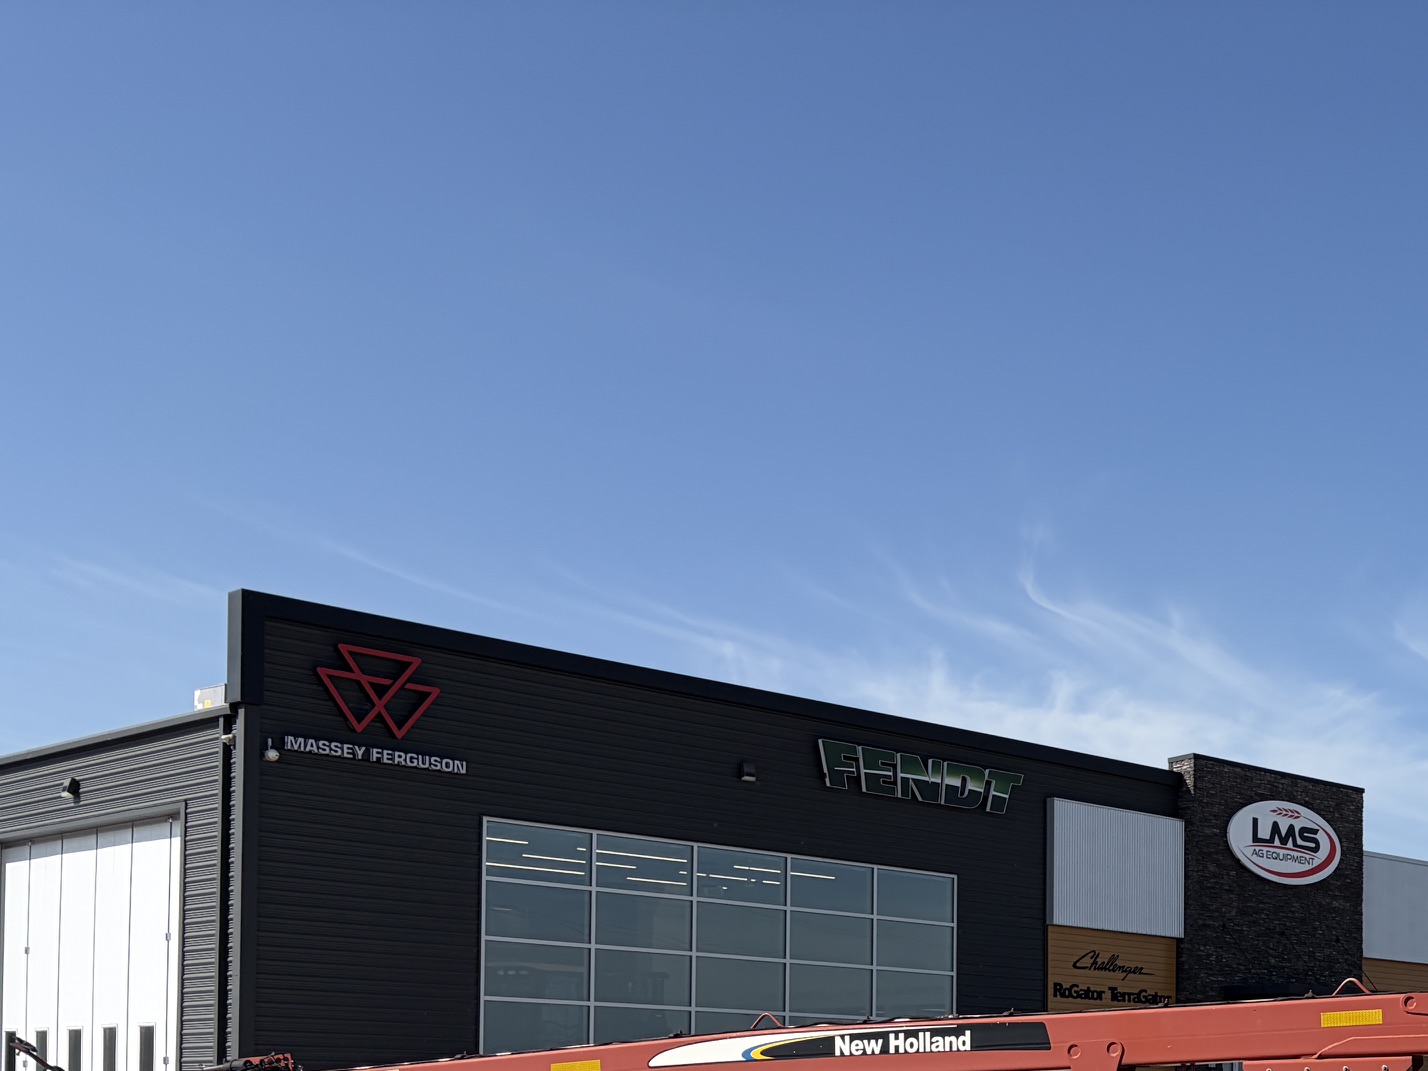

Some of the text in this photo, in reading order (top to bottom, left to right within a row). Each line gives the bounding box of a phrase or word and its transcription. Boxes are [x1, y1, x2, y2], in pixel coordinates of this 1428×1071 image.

[285, 735, 467, 774] MASSEY FERGUSON
[818, 738, 1024, 814] FENDT
[1252, 817, 1320, 854] LMS
[1251, 849, 1315, 866] AG EQUIPMENT
[1072, 950, 1155, 981] Challenger
[1053, 982, 1172, 1005] RoGator TerraGator
[834, 1030, 971, 1056] New Holland
